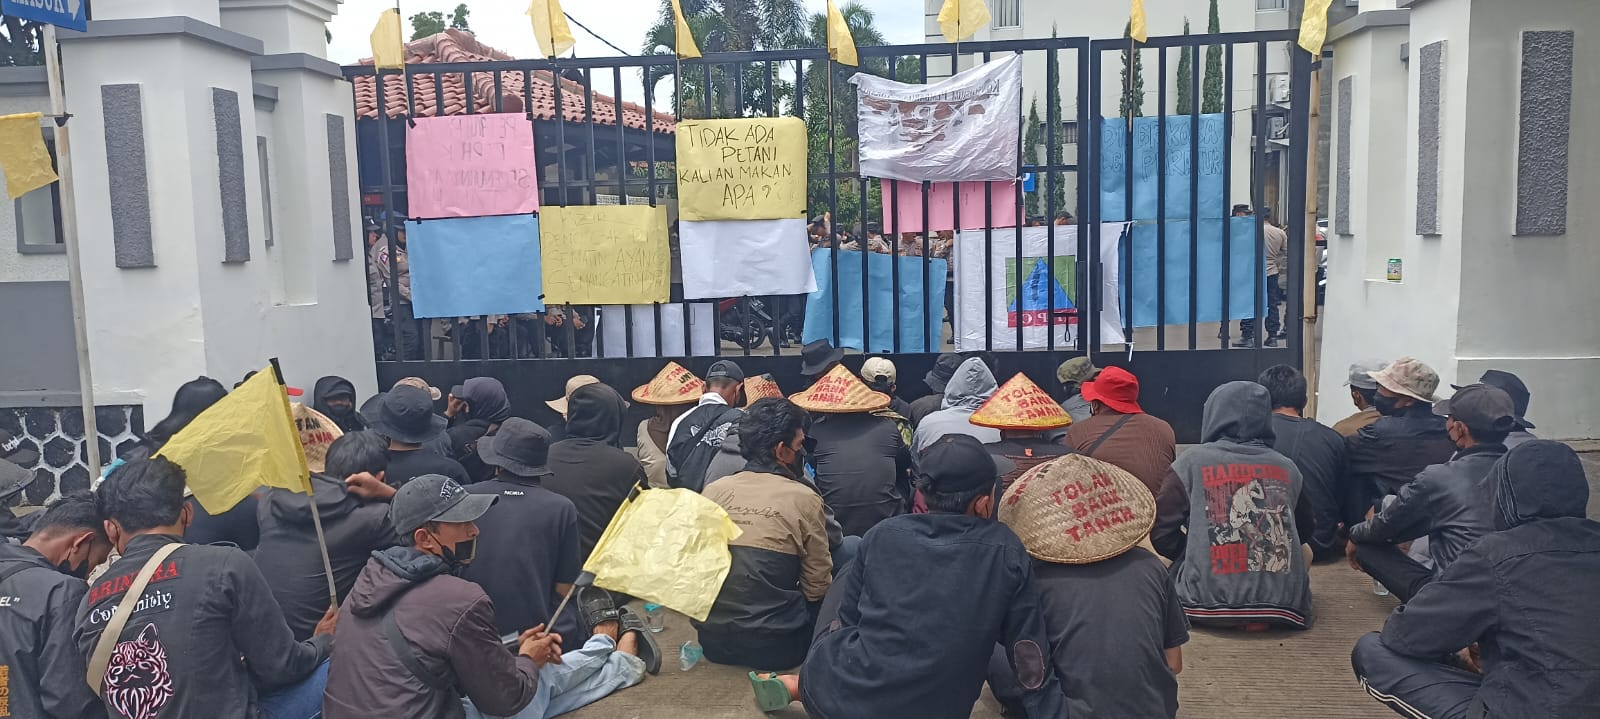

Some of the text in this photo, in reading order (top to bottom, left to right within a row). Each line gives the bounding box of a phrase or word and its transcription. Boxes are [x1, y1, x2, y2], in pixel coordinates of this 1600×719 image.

[680, 124, 774, 148] TIDAK ADA
[721, 146, 777, 163] PETANI
[680, 163, 792, 186] KALIAN MAKAN
[722, 183, 755, 209] APA
[1050, 472, 1113, 506] TOLAK
[1071, 488, 1123, 519] BANK
[1065, 506, 1136, 543] TANAH
